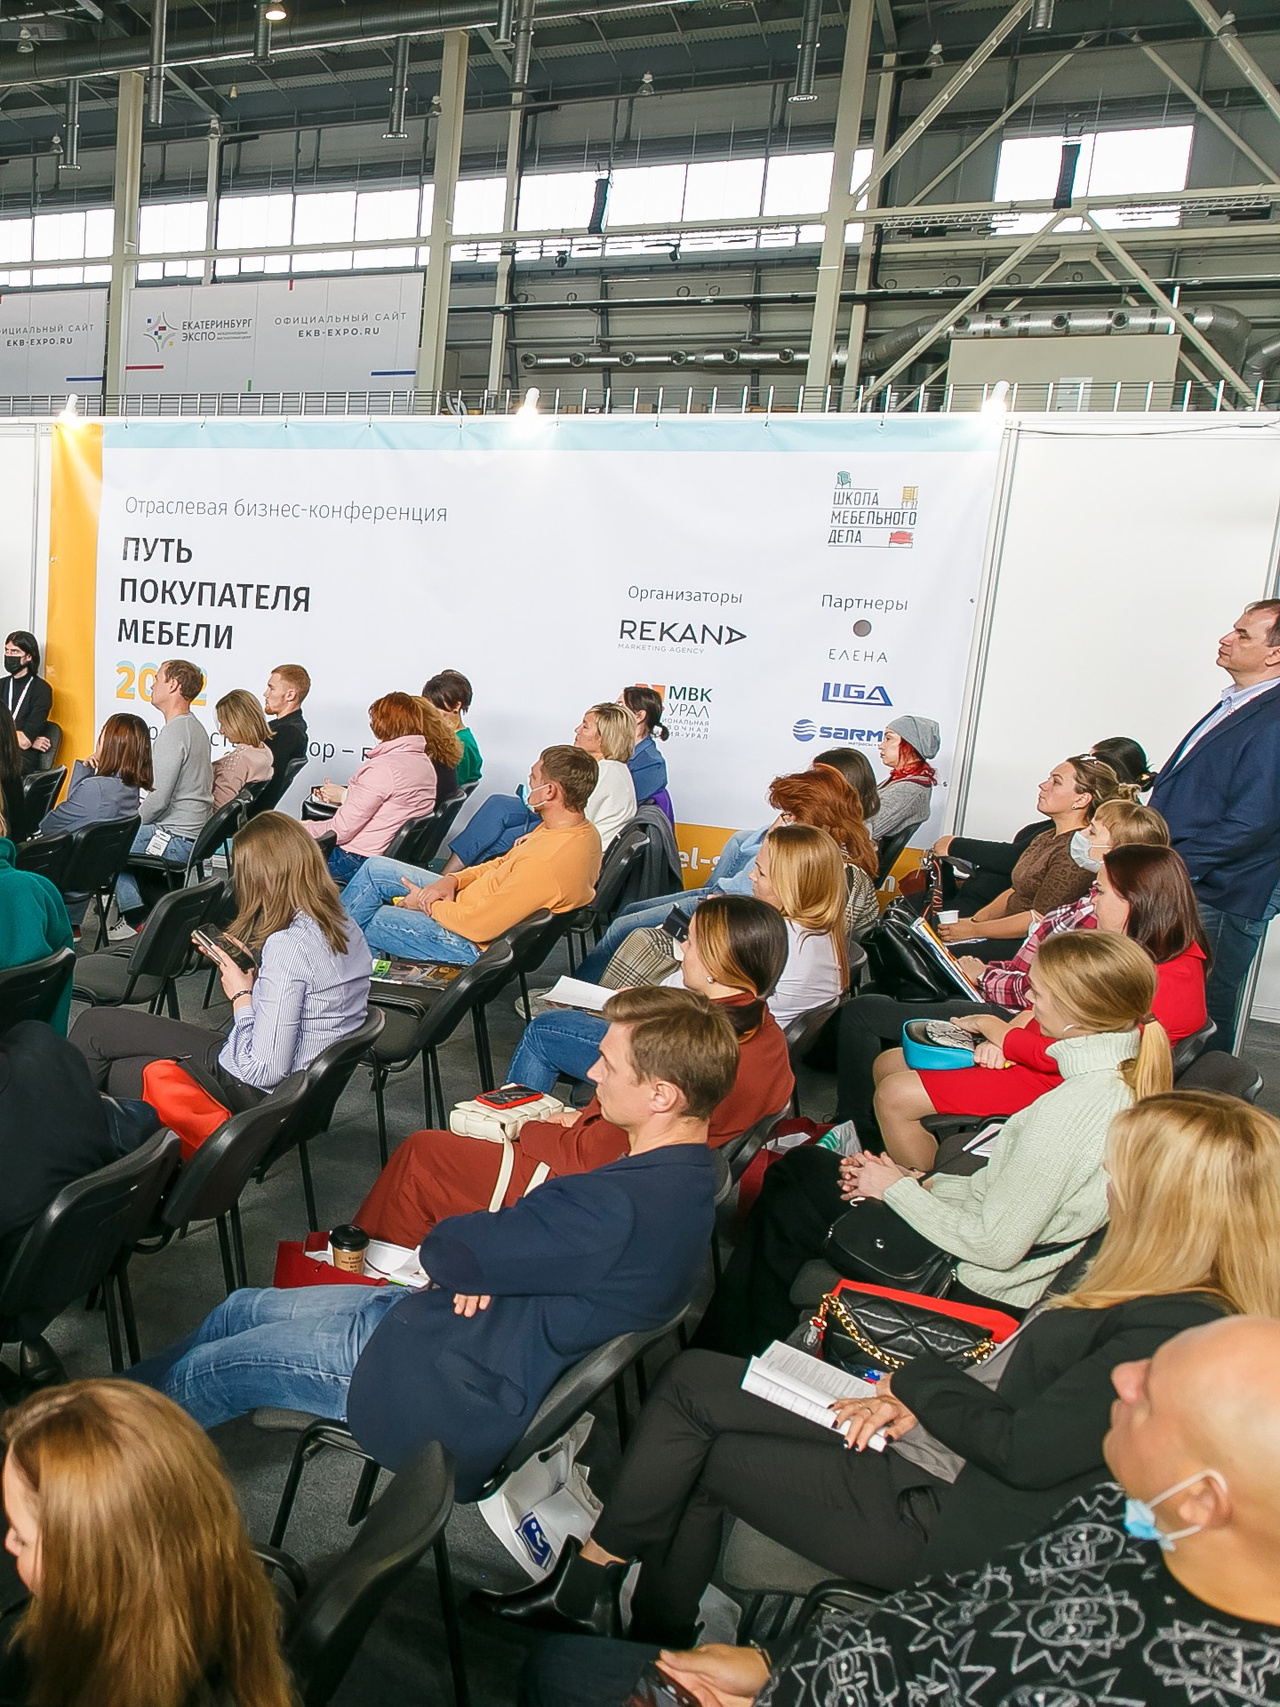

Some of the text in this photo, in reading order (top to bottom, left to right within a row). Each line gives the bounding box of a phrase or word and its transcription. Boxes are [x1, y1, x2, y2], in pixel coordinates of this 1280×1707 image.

[182, 318, 252, 331] ЕКАТЕРИНБУРГ
[275, 312, 407, 325] ОФИЦИАЛЬНЫЙ САЙТ
[68, 324, 94, 332] САЙТ
[298, 327, 380, 337] EKB-EXPO.RU
[7, 338, 73, 347] EKB-EXPO.RU
[181, 332, 216, 341] ЭКСПО
[833, 492, 879, 505] ШКОЛА
[125, 496, 447, 524] Отраслевая бизнес-конференция
[831, 511, 917, 525] МЕБЕЛЬНОГО
[828, 530, 862, 544] ДЕЛА
[122, 537, 192, 564] ПУТЬ
[120, 578, 310, 612] ПОКУПАТЕЛЯ
[628, 586, 742, 606] Организаторы
[822, 595, 908, 613] Партнеры
[118, 618, 233, 649] МЕБЕЛИ
[617, 644, 704, 654] MARKETING AGENCY
[828, 649, 888, 663] ЕЛЕНА
[669, 686, 713, 703] МВК
[822, 682, 893, 707] LIGA
[669, 703, 709, 719] УРАЛ
[662, 718, 709, 726] ИОНАЛЬНАЯ
